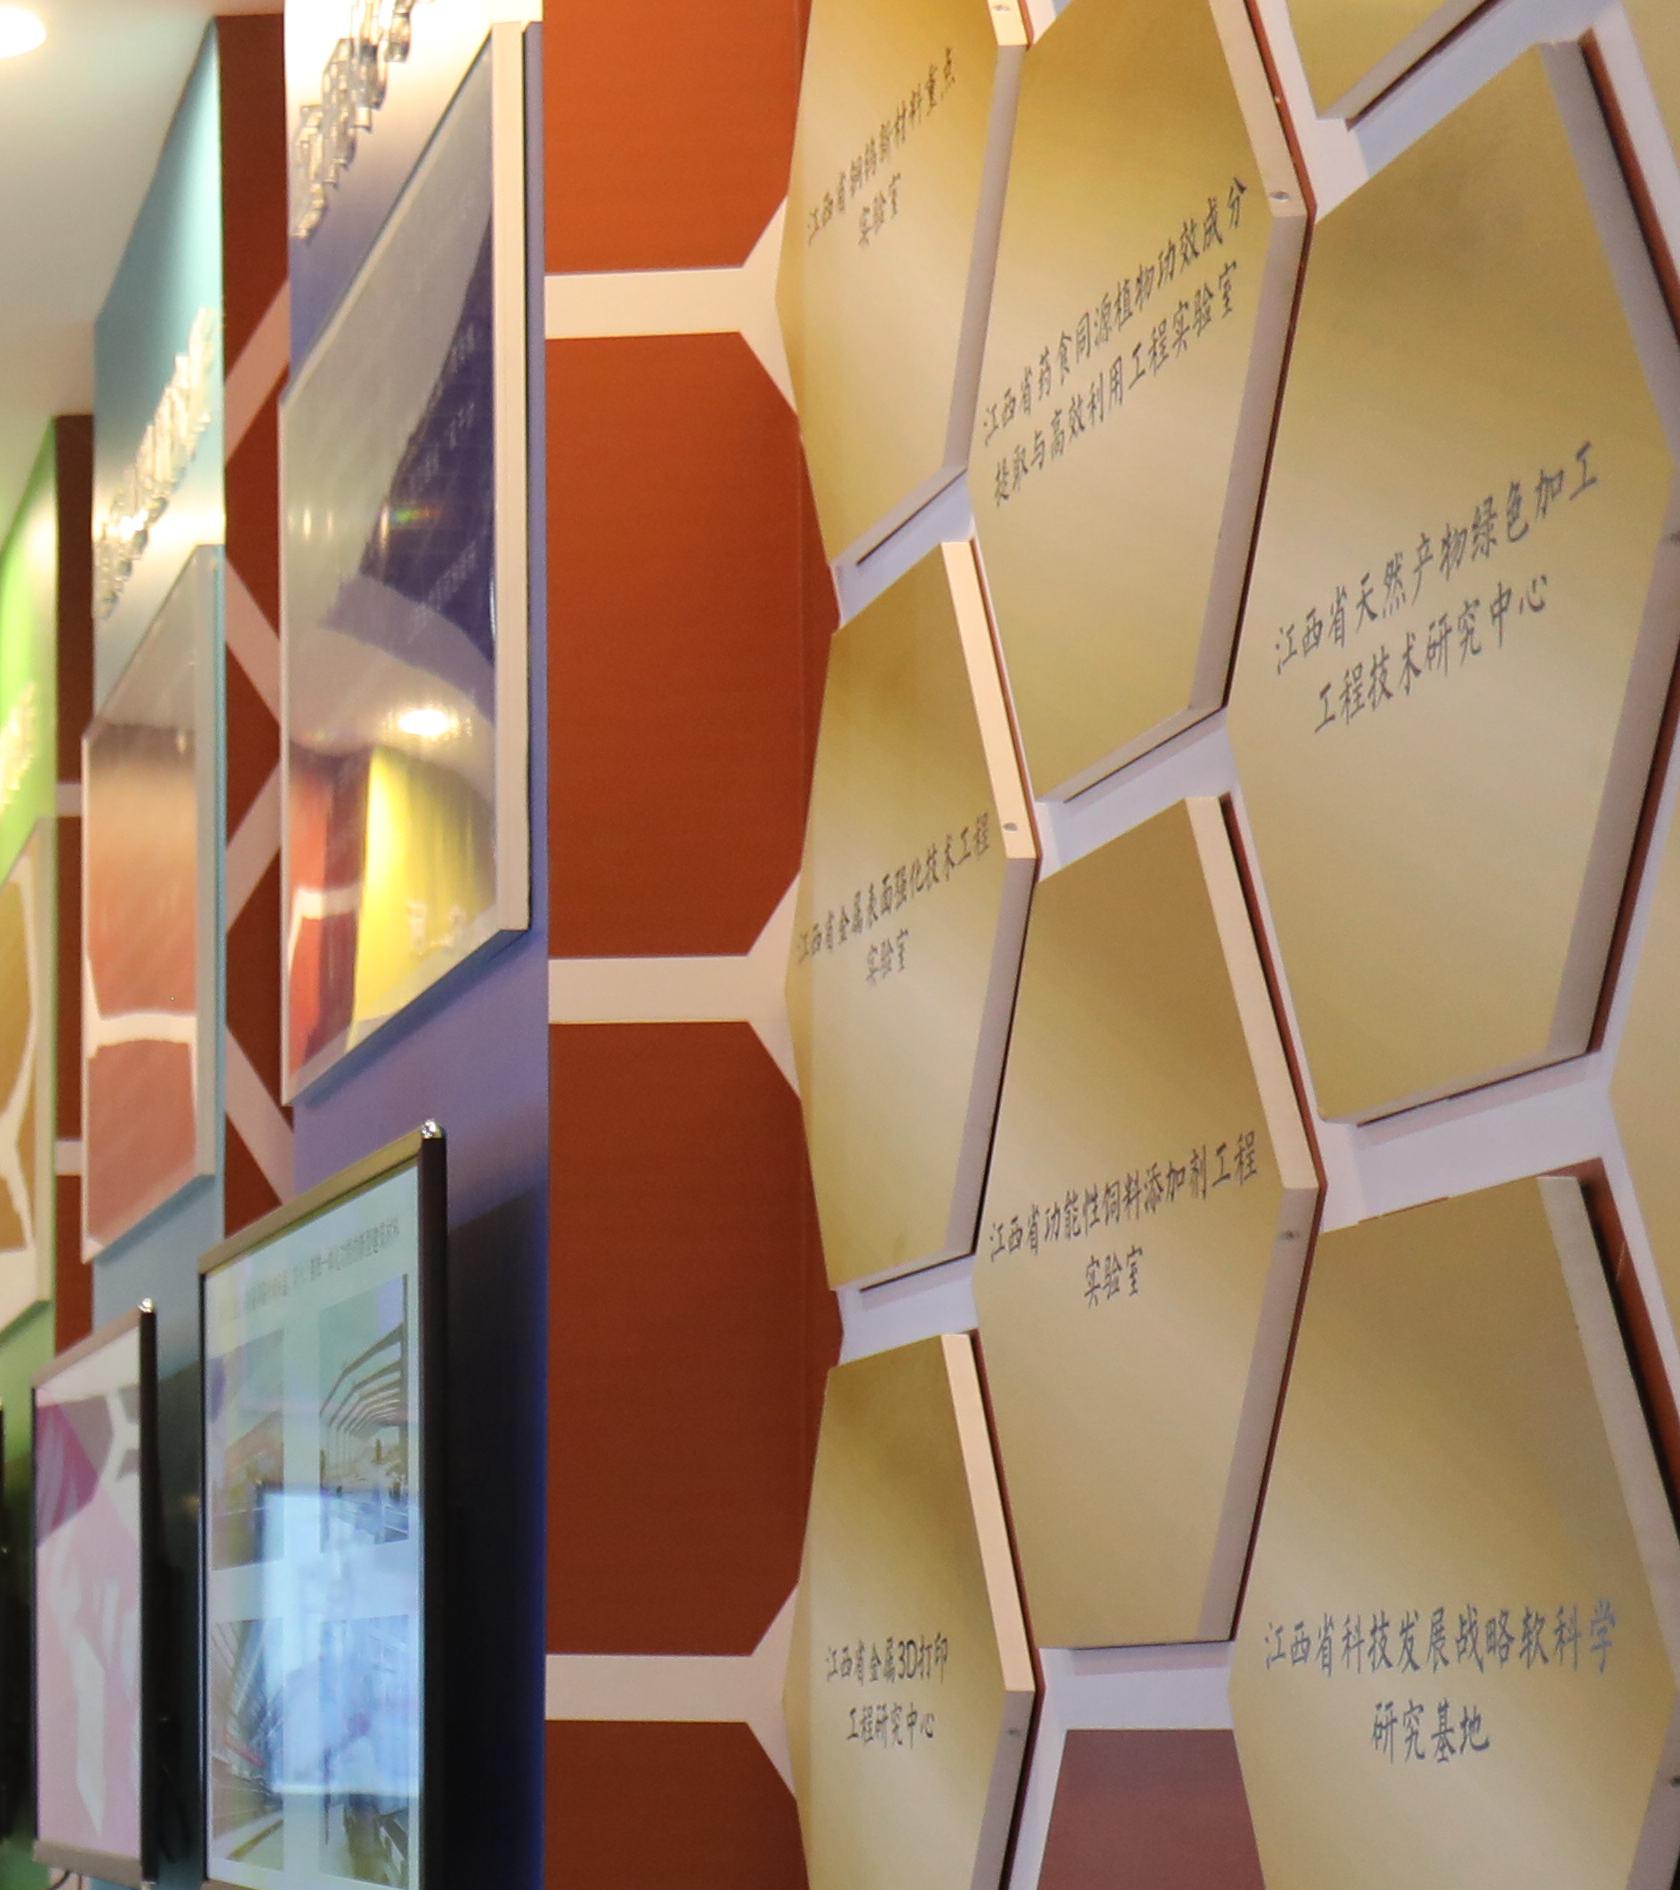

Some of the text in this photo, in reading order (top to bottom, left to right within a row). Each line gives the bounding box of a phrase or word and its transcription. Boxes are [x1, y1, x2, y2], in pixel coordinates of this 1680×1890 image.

[983, 176, 1247, 448] 江西省药食同源植物功效成分
[994, 259, 1238, 507] 提取与高效利用工程实验室
[1274, 440, 1598, 676] 江西省天然产物绿色加工
[1314, 573, 1549, 734] 工程技术研究中心
[989, 1130, 1259, 1263] 江西省功能性饲料添加剂工程
[1084, 1244, 1144, 1309] 实验室
[825, 1632, 949, 1687] 江西省金属3D打印
[1264, 1598, 1617, 1678] 江西省科技发展战略软科学
[846, 1701, 936, 1750] 工程研究中心
[1371, 1697, 1491, 1765] 研究基地
